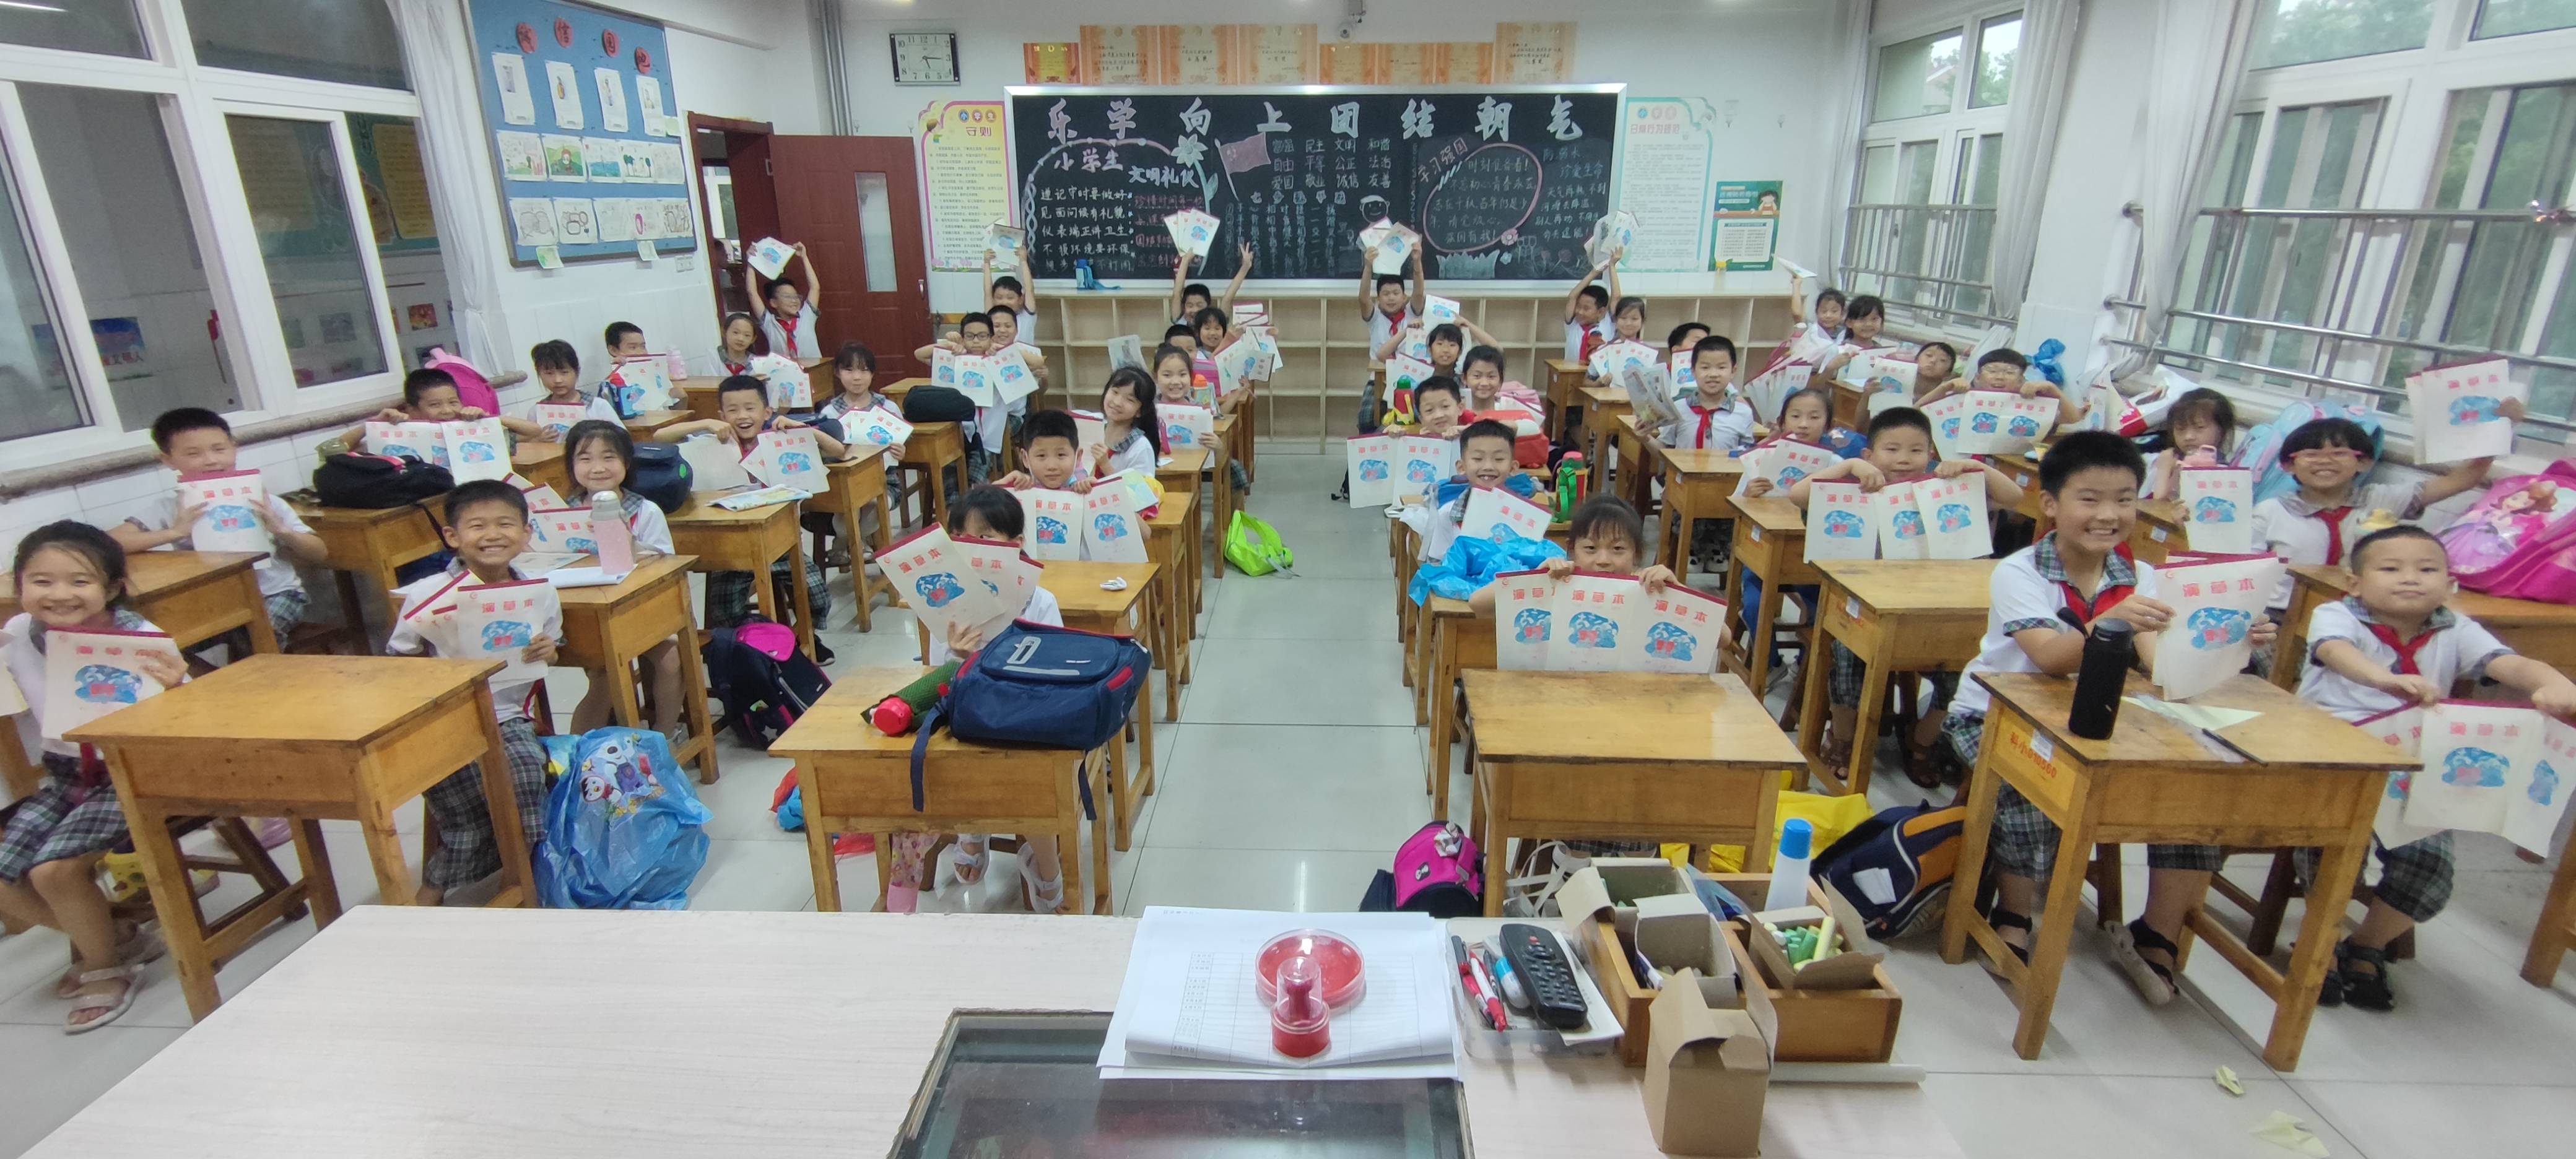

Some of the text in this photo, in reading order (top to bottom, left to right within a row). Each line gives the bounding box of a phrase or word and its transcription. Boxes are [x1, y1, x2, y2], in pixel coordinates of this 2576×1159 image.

[1048, 95, 1583, 144] 乐学向上团结朝气
[1272, 137, 1391, 153] 富强 民主 文明 和谐
[1054, 147, 1124, 173] 小学生
[1274, 155, 1391, 172] 自由 平等 公正 法治
[1417, 137, 1468, 183] 学习强国
[1128, 165, 1199, 188] 文明礼仪
[1271, 173, 1391, 189] 爱国 敬业 诚信 友善
[1040, 206, 1126, 222] 见面问候有礼貌
[1042, 225, 1129, 240] 仪表端正讲卫生
[2182, 578, 2255, 597] 演草本
[1572, 589, 1625, 604] 演草本
